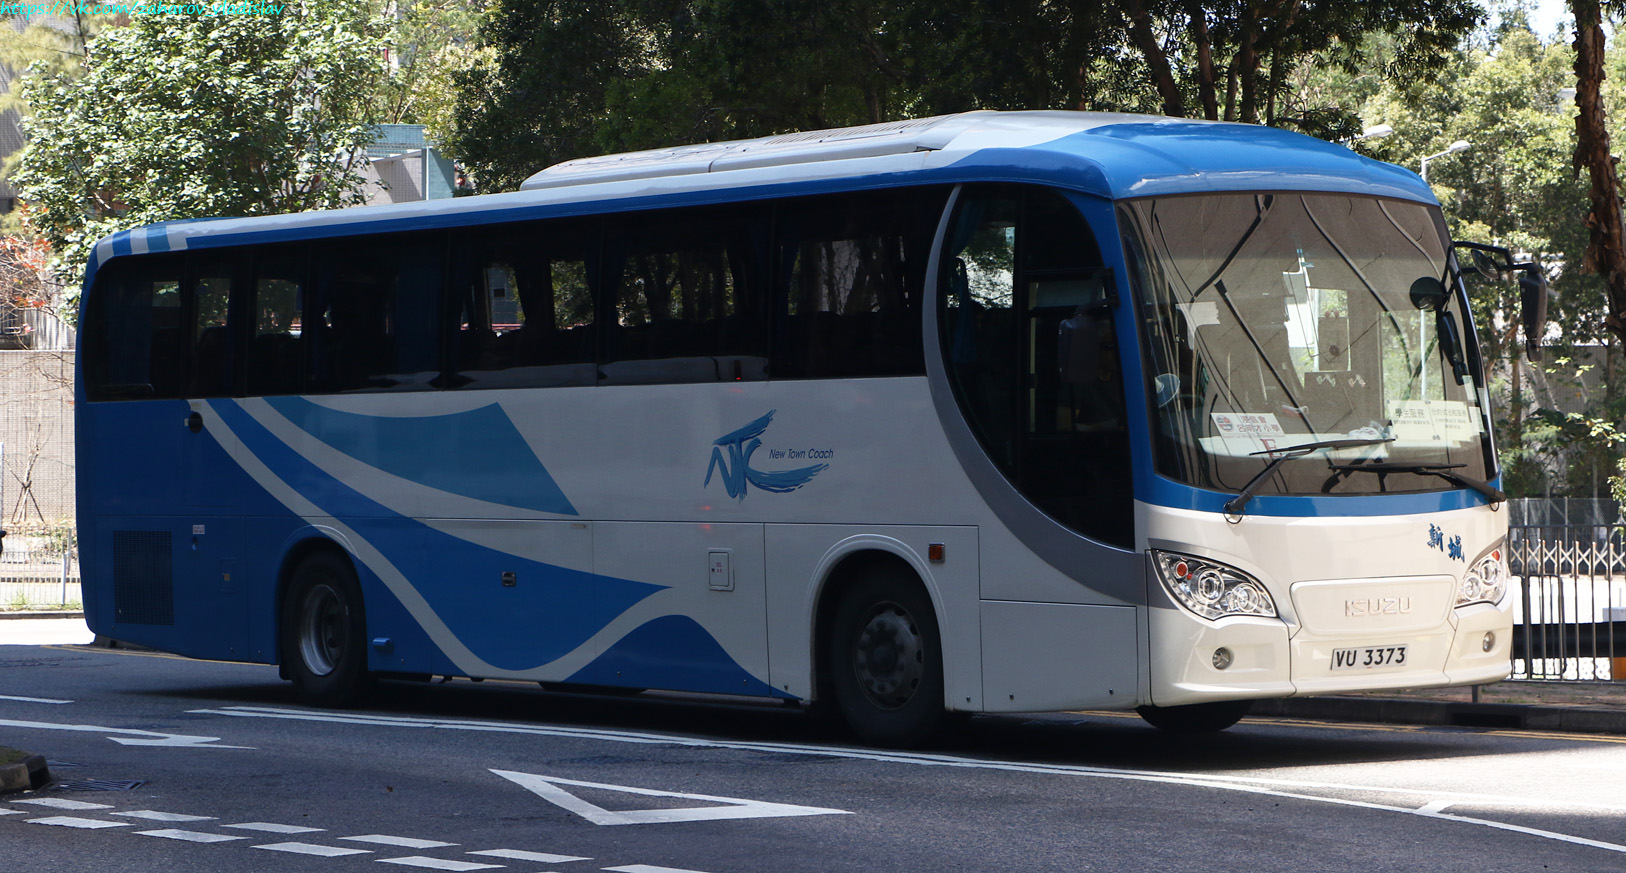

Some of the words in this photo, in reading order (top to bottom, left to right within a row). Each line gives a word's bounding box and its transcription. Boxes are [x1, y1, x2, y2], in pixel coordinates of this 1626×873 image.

[769, 449, 785, 459] New
[787, 449, 806, 459] Town
[808, 448, 834, 459] Coach
[1427, 523, 1466, 563] 新城
[1345, 597, 1414, 617] ISUZU
[1336, 650, 1357, 668] VU
[1363, 647, 1406, 666] 3373
